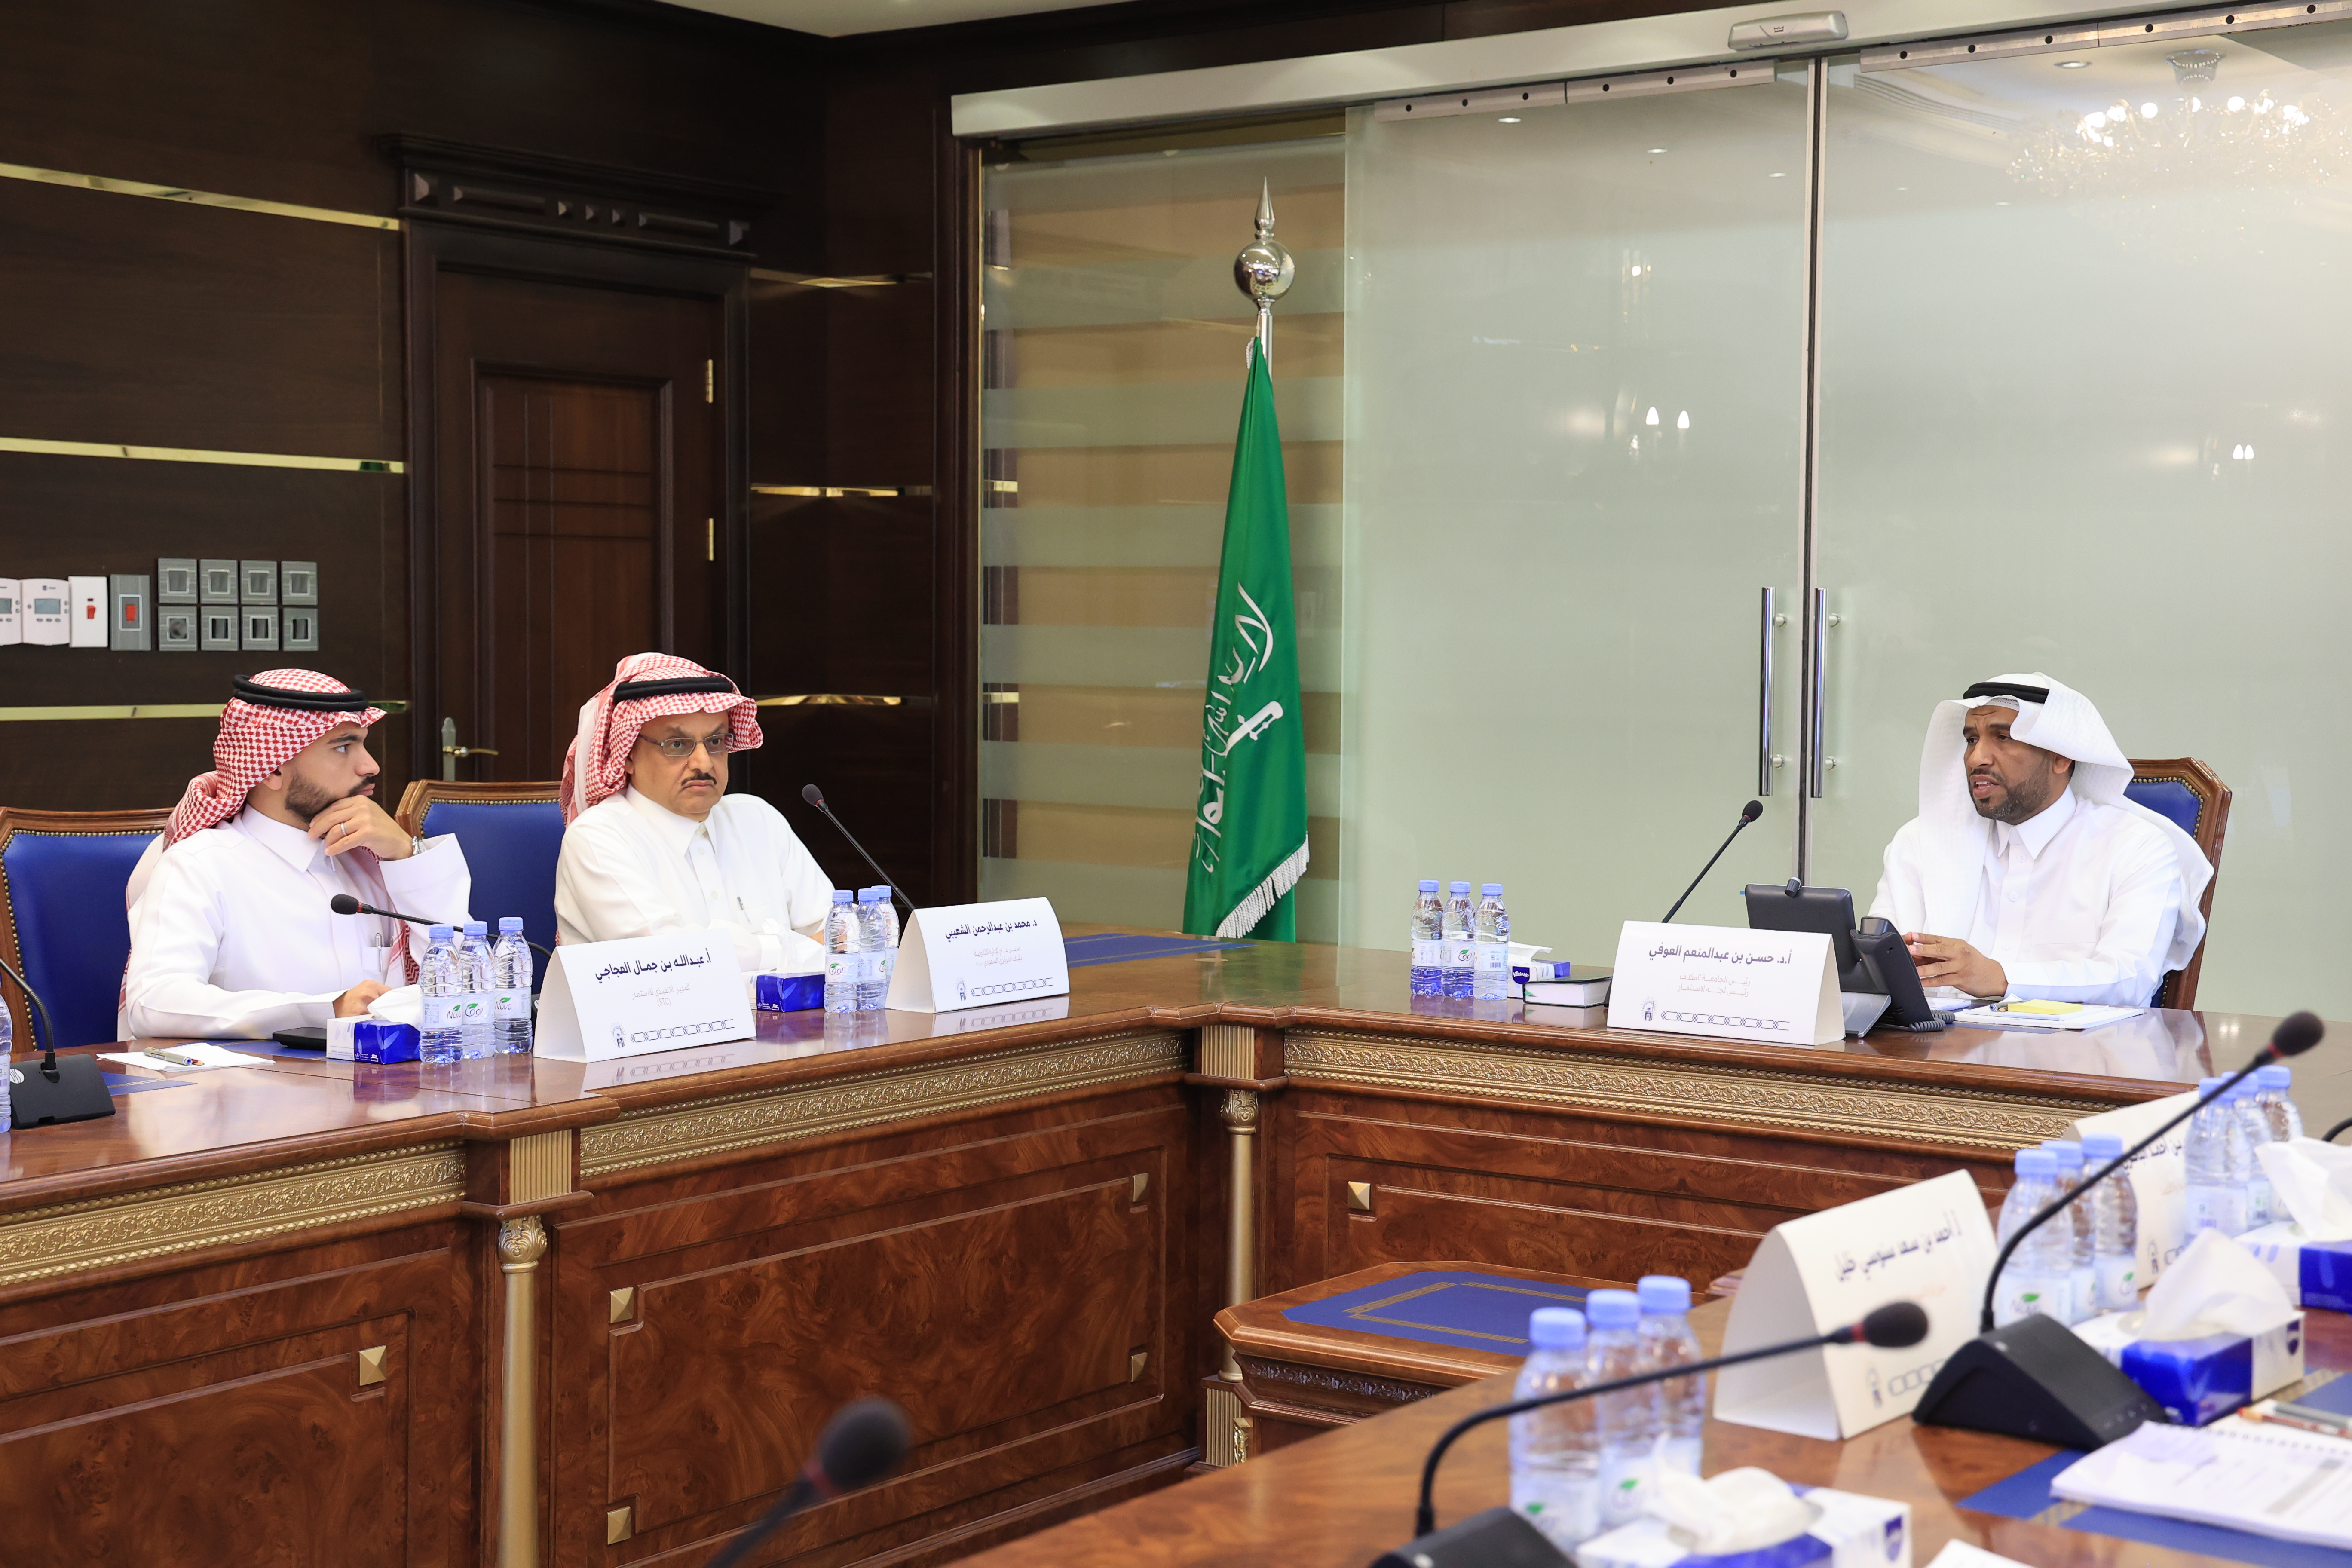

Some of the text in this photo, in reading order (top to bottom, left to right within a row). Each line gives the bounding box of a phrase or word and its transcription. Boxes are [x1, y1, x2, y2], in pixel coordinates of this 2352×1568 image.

[973, 921, 1004, 937] عبدالرحمن
[1005, 922, 1014, 933] بن
[1014, 921, 1031, 929] محمد
[945, 923, 971, 943] الشعيبي
[974, 948, 989, 957] القانونية
[999, 946, 1008, 956] عام
[1649, 942, 1682, 961] العوفي
[1683, 947, 1730, 963] عبدالمنعم
[674, 954, 705, 968] عبدالله
[983, 956, 999, 968] السعودي
[999, 955, 1012, 966] المركزي
[1012, 954, 1023, 962] بالبنك
[1731, 952, 1743, 964] بن
[1745, 952, 1774, 965] حسن
[595, 961, 631, 984] العجاجي
[634, 960, 658, 975] جمال
[660, 960, 673, 973] بن
[1679, 972, 1750, 986] رئيس الجامعة المكلف
[632, 983, 690, 1000] المدير التنفيذي للاستثمار
[1677, 983, 1749, 998] رئيس لجنة الاستثمار
[495, 1001, 512, 1010] Nova
[657, 997, 671, 1008] (STC)
